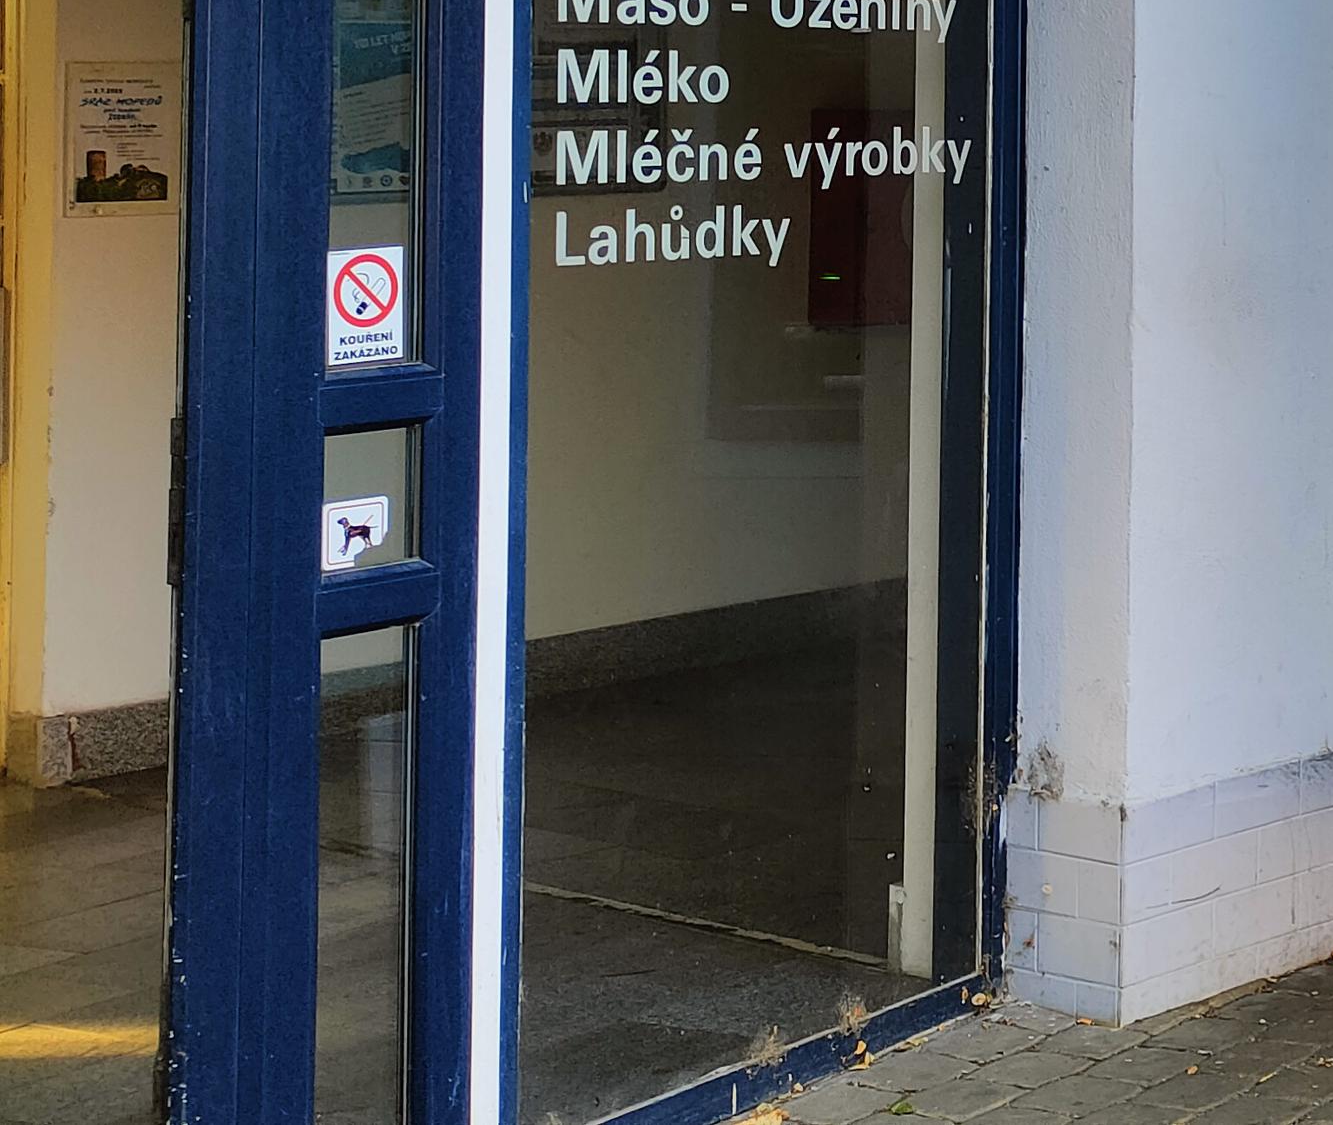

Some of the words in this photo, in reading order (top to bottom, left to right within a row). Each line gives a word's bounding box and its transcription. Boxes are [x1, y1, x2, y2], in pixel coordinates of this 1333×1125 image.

[556, 48, 730, 105] Mléko
[555, 127, 762, 186] Mléčné
[783, 126, 972, 190] výrobky
[554, 205, 791, 267] Lahůdky
[334, 345, 398, 361] ZAKÁZÁNO
[339, 329, 393, 346] KOUŘENÍ
